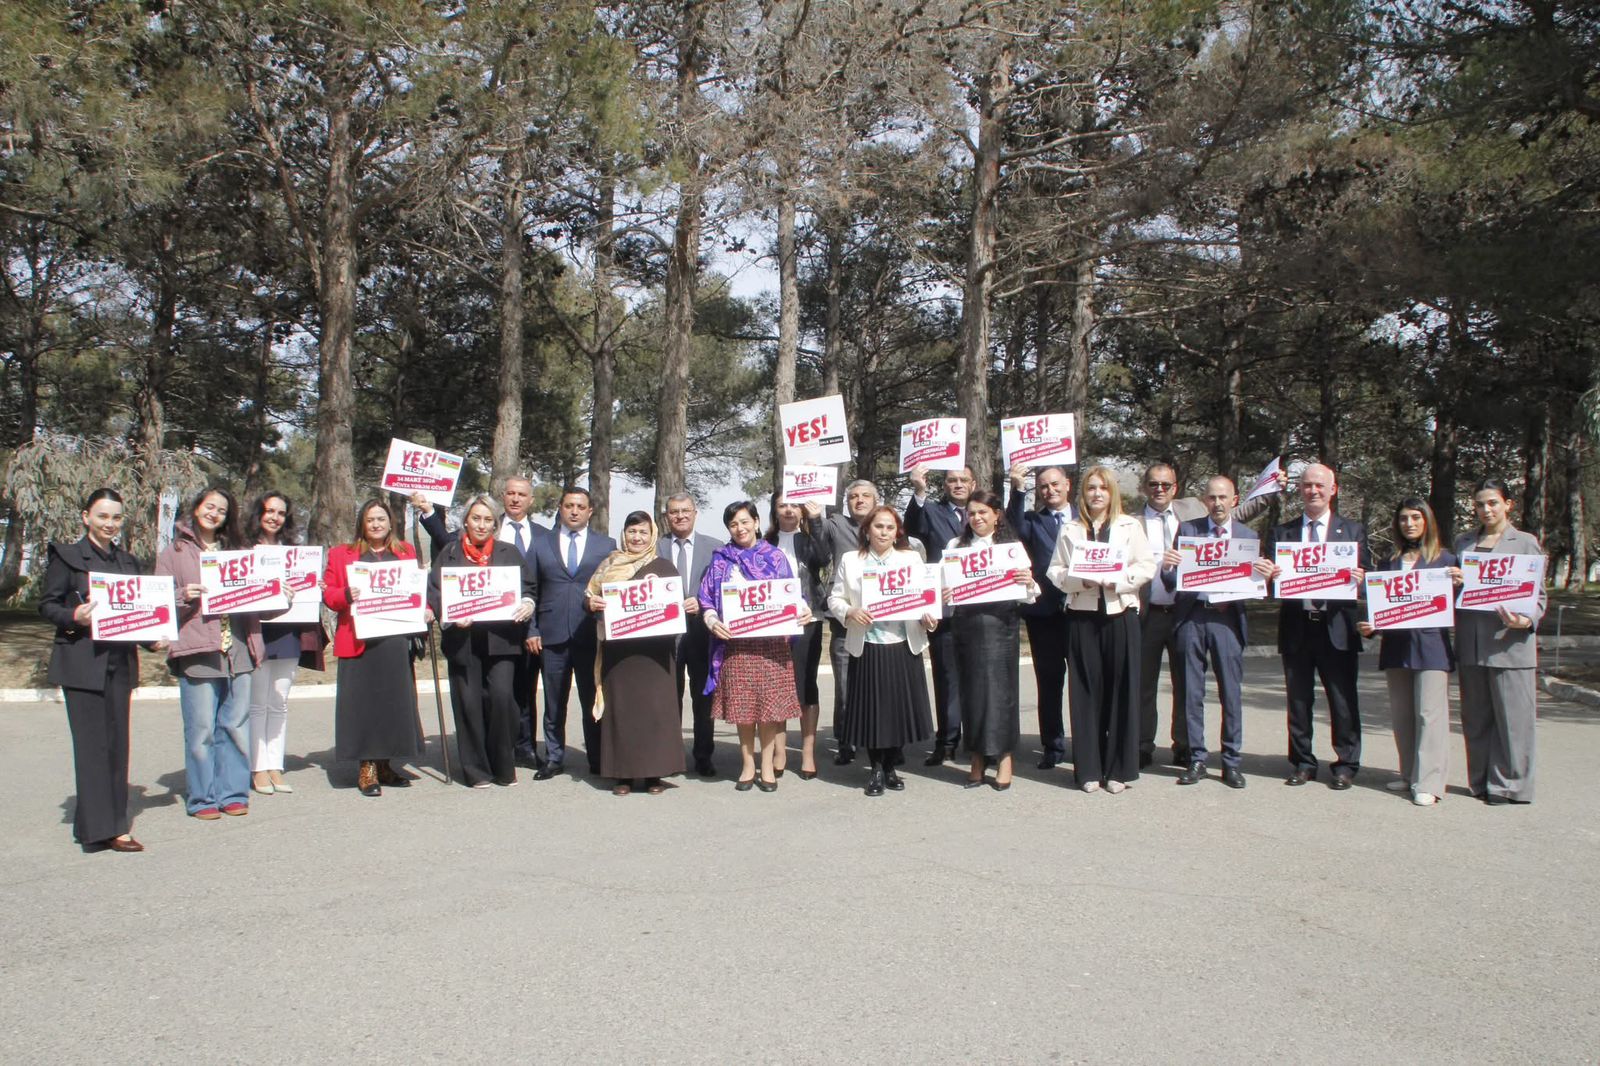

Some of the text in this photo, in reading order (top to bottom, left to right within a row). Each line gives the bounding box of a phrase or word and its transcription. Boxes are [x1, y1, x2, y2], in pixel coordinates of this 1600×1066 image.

[785, 414, 828, 447] YES!
[912, 420, 939, 447] YES!
[1018, 416, 1049, 443] YES!
[401, 450, 438, 468] YES!
[795, 472, 817, 484] YES!
[961, 547, 993, 574] YES!
[1085, 548, 1109, 561] YES!
[1195, 539, 1229, 562] YES!
[1292, 543, 1327, 569] YES!
[219, 553, 254, 583] YES!
[369, 567, 402, 588] YES!
[459, 568, 491, 593] YES!
[879, 566, 911, 592] YES!
[1478, 556, 1515, 579] YES!
[106, 576, 141, 605] YES!
[620, 580, 653, 609] YES!
[739, 581, 772, 608] YES!
[1384, 571, 1419, 599] YES!
